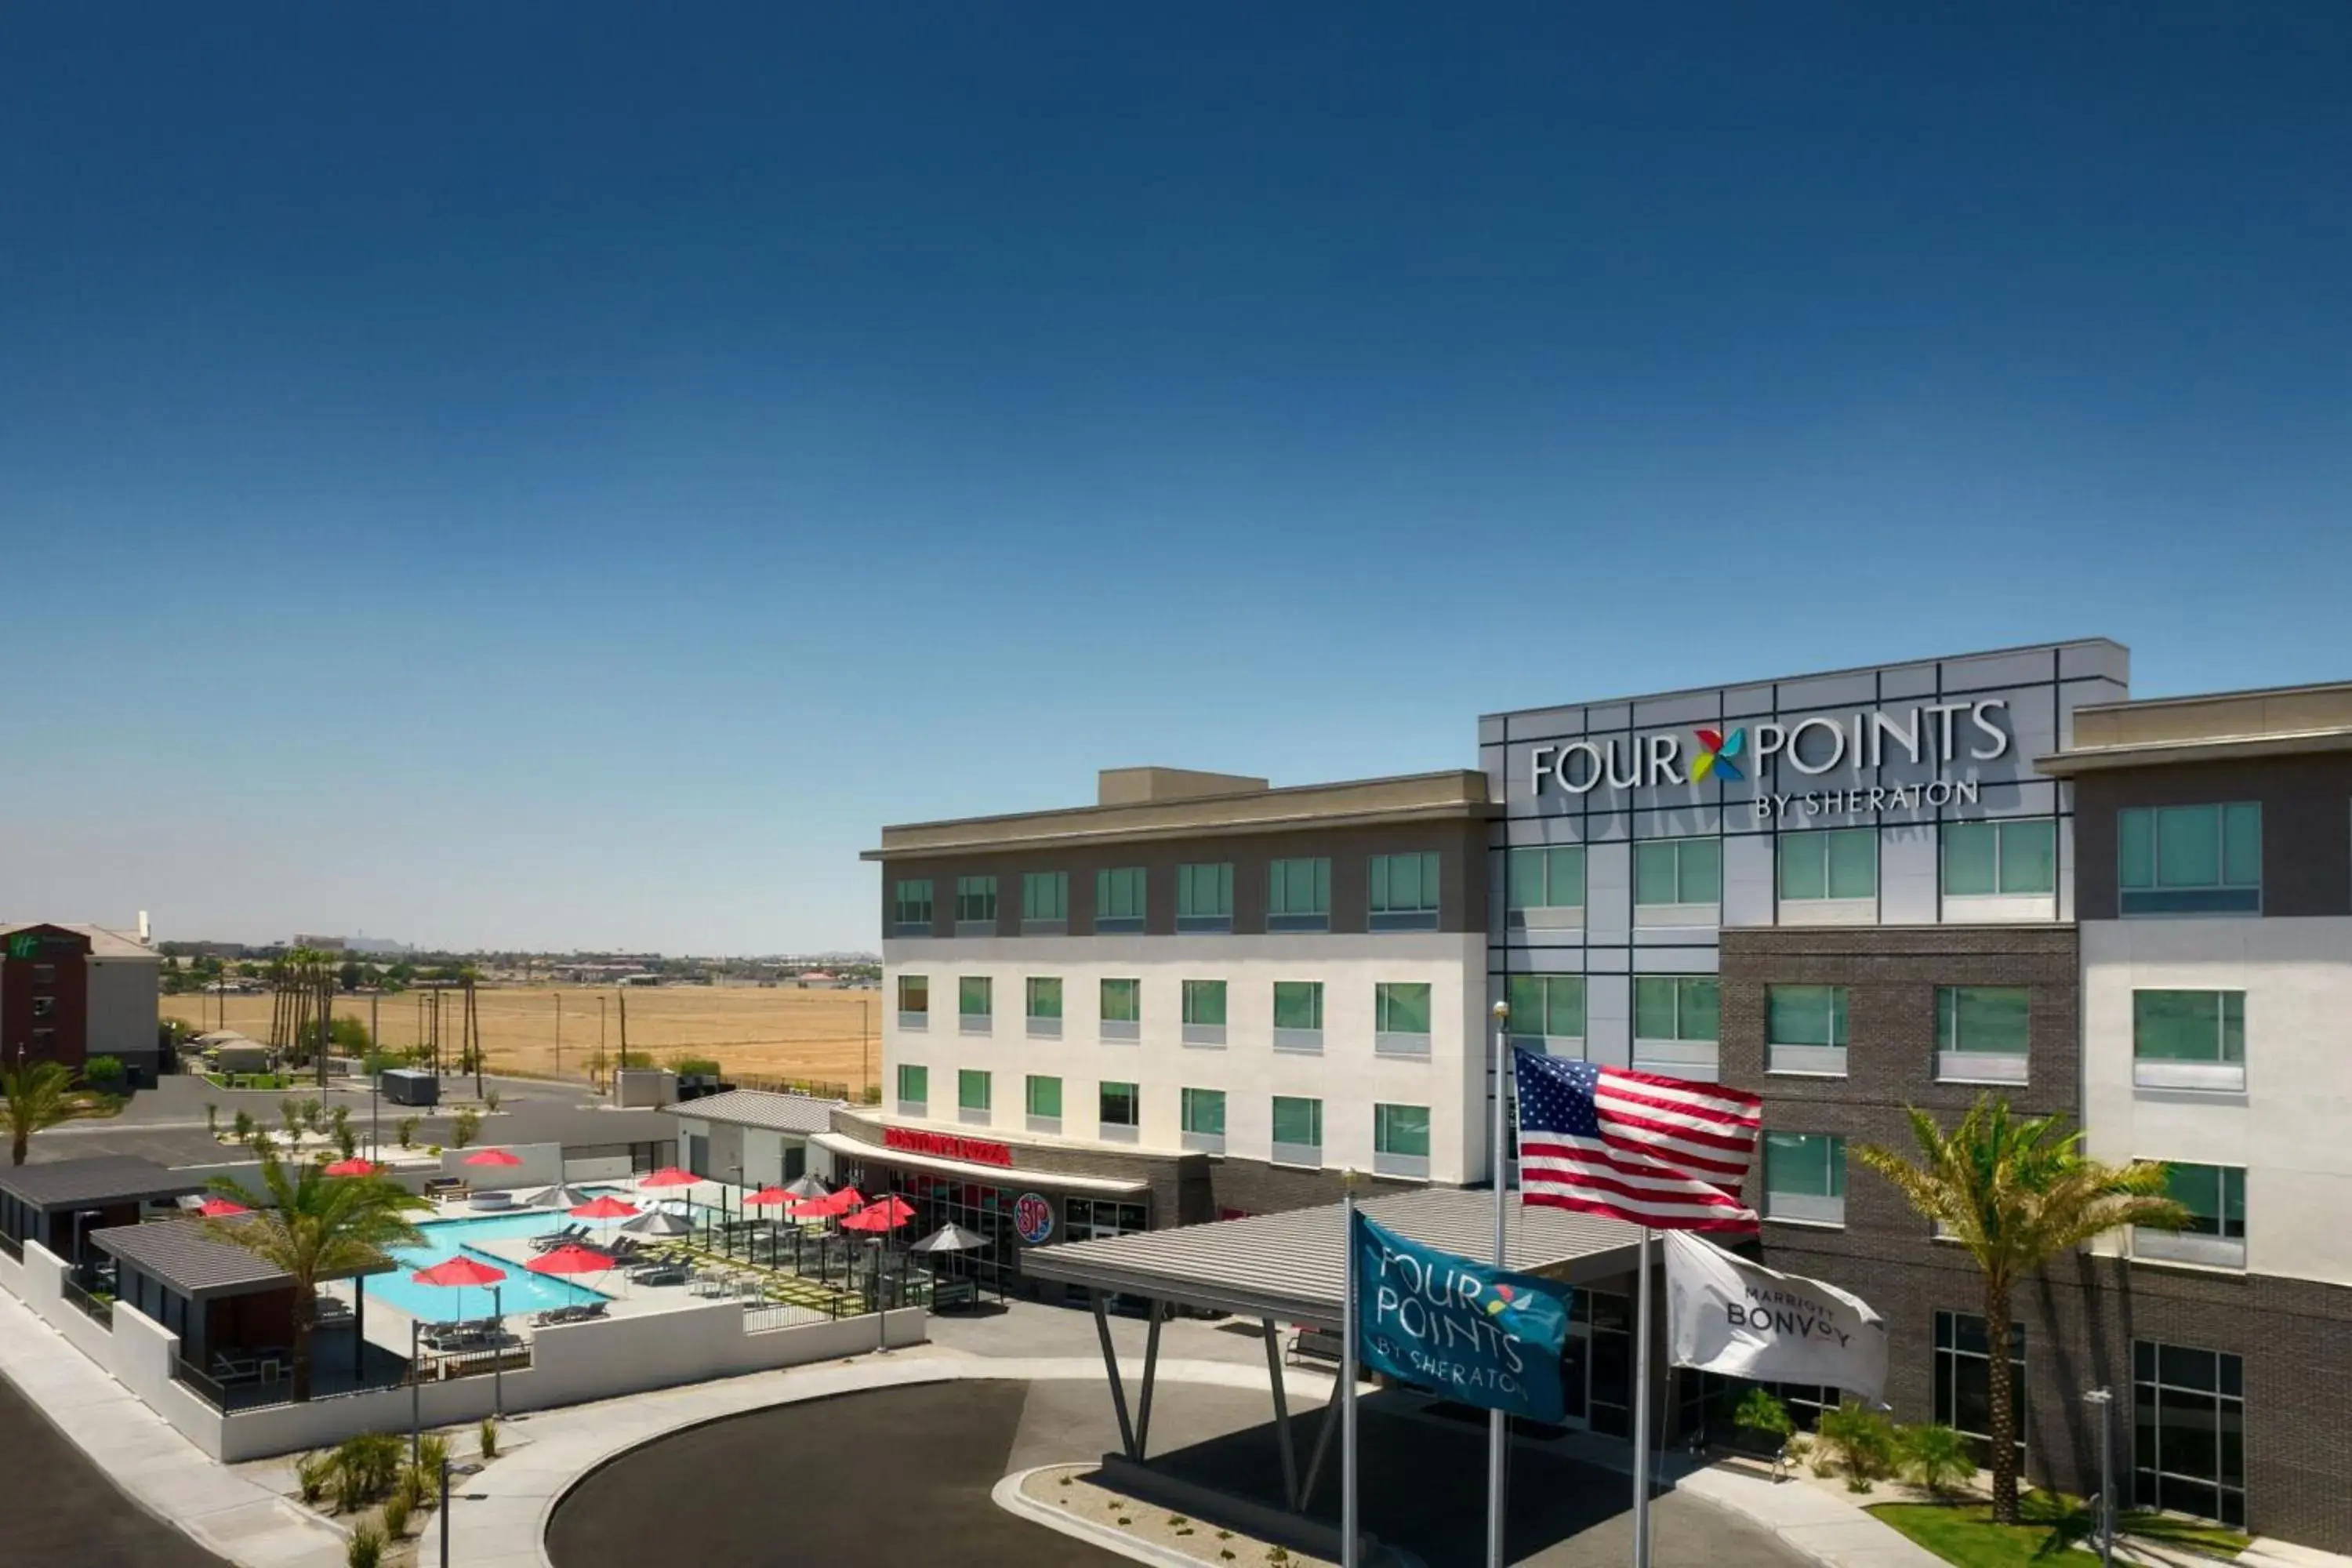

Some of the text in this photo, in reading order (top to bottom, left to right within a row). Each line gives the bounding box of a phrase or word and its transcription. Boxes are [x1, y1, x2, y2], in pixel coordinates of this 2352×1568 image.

[1530, 699, 2009, 795] FOUR POINTS
[1755, 779, 1980, 818] BY SHERATON
[1380, 1246, 1485, 1316] FOUR
[1377, 1286, 1524, 1374] POINTS
[1377, 1336, 1400, 1359] BY
[1727, 1302, 1850, 1348] BONVOY
